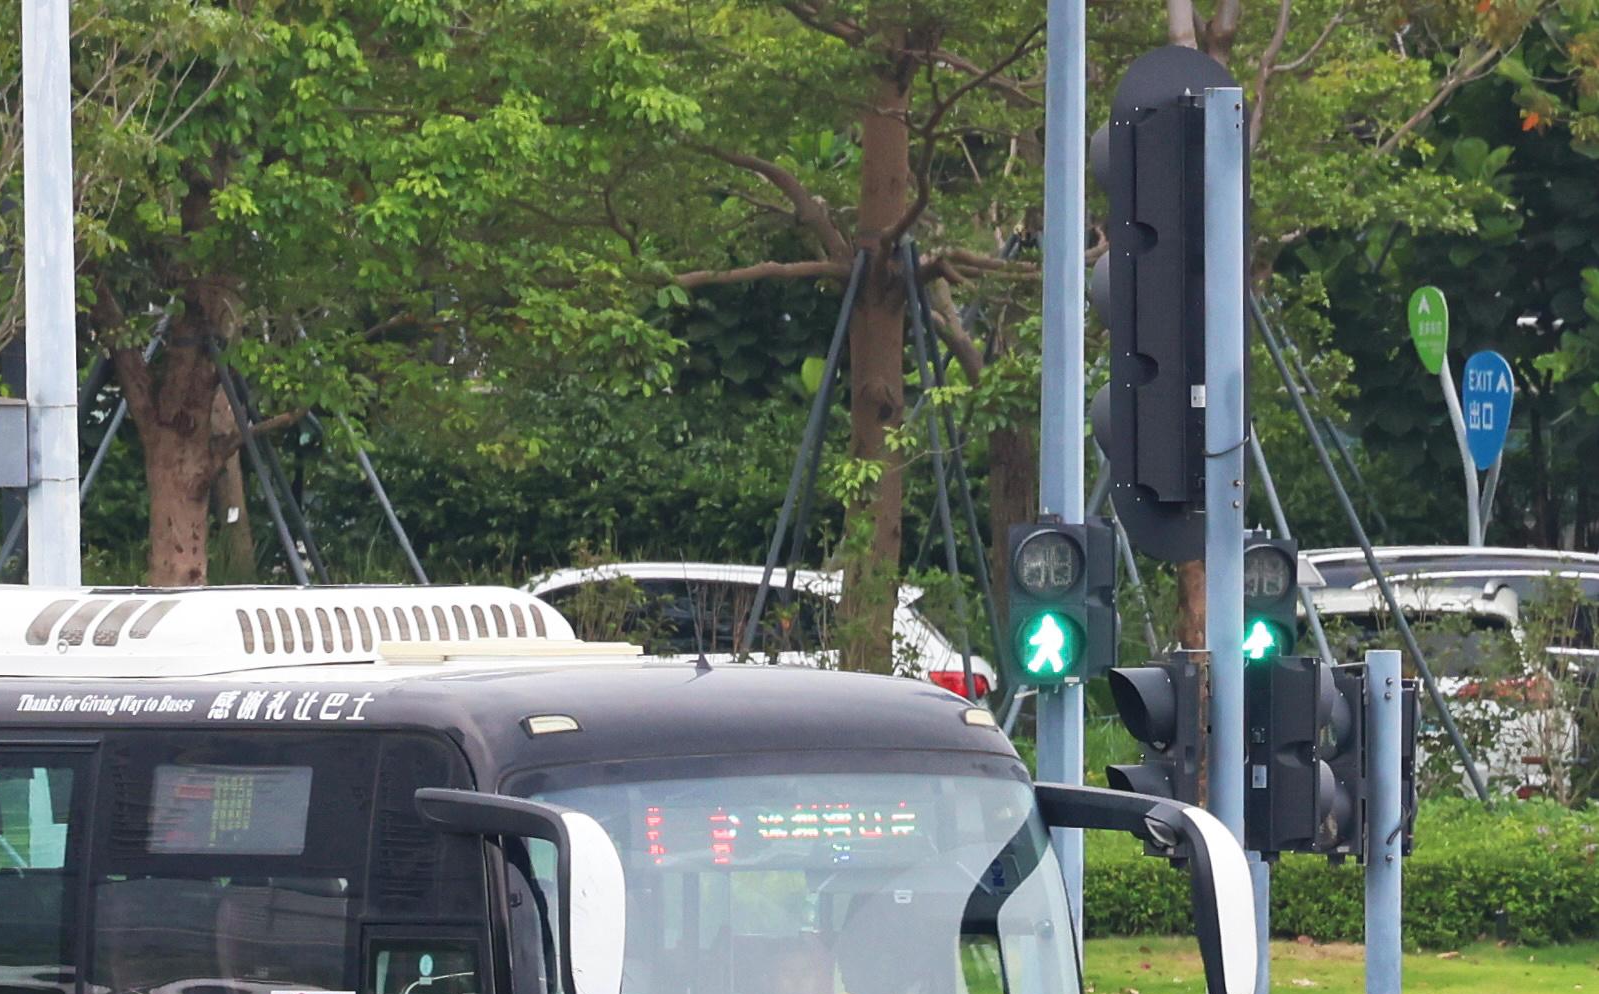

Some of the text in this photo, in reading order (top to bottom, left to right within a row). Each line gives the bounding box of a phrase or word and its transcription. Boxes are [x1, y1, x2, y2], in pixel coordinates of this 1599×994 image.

[1468, 369, 1493, 392] EXIT
[1469, 400, 1494, 430] 出口
[17, 694, 195, 716] Thanks for Giving Way to Buses
[207, 690, 375, 721] 感谢礼让巴士
